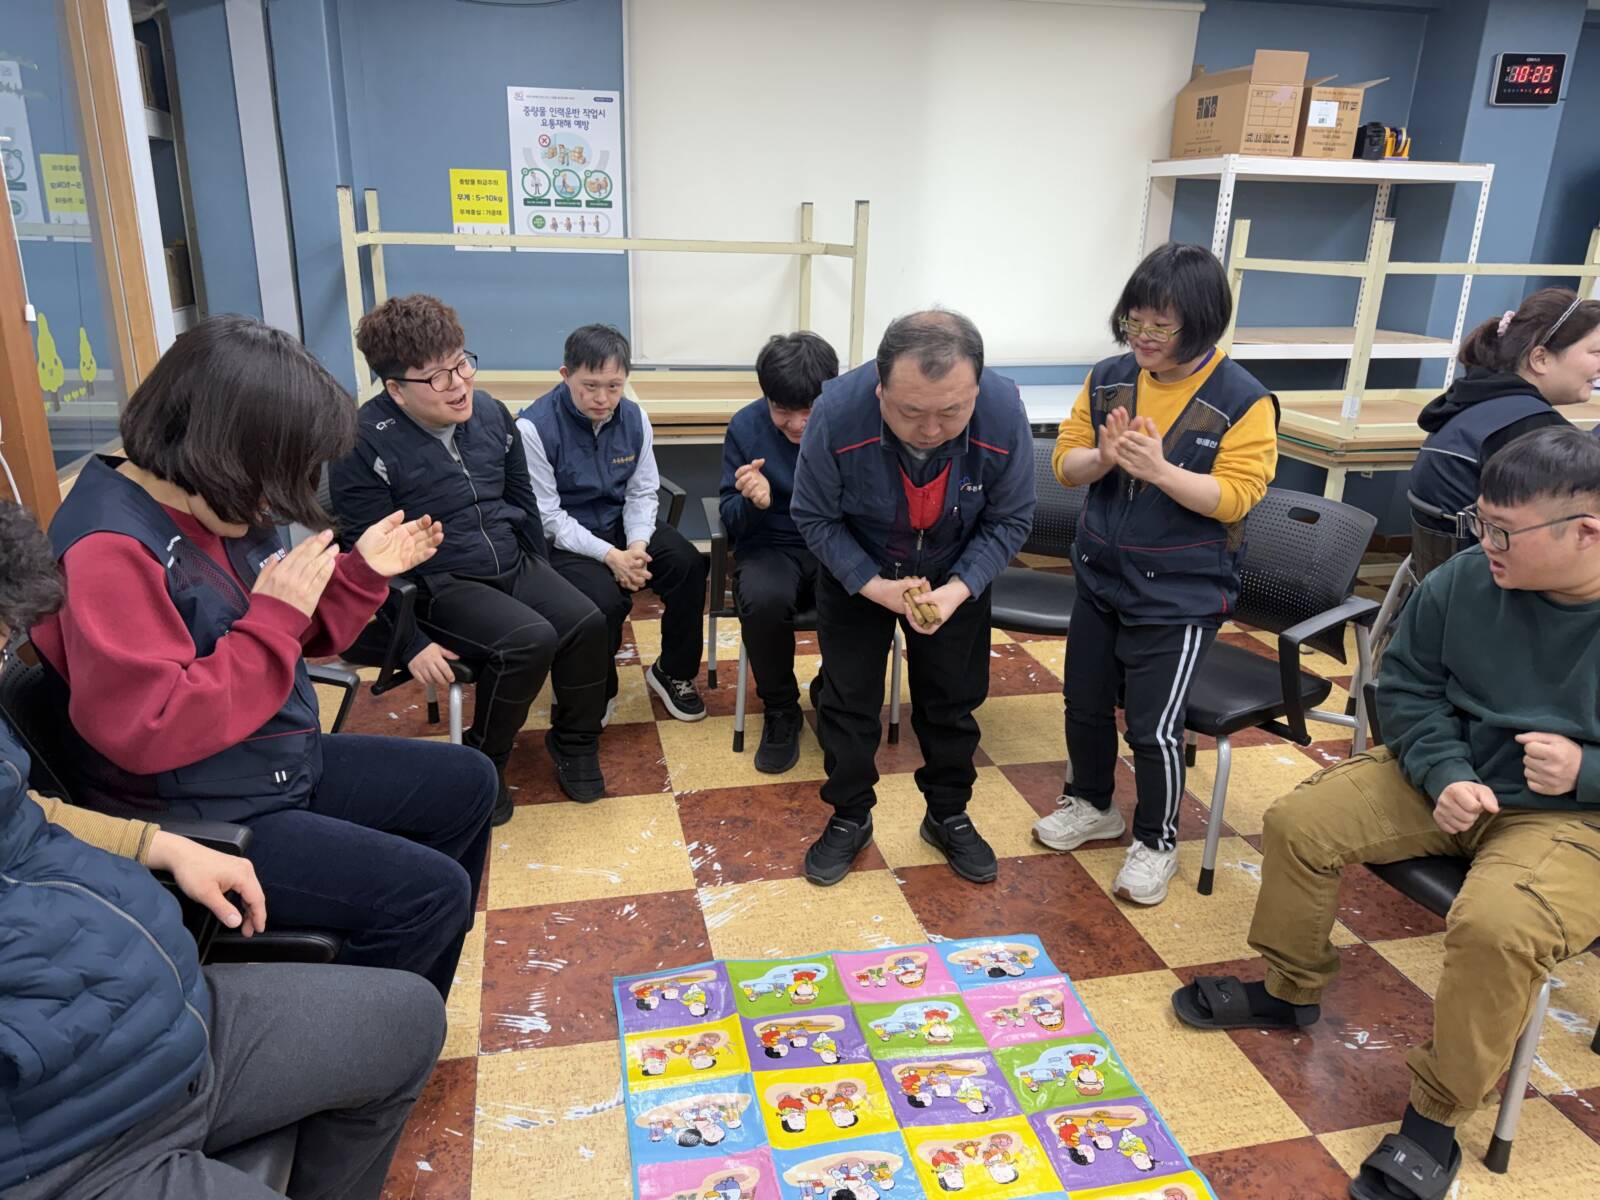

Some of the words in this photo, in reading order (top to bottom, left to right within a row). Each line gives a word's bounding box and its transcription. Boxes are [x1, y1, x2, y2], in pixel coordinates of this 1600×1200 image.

[1512, 65, 1554, 83] 10:23
[523, 106, 547, 117] 중량물
[549, 107, 580, 118] 인력운반
[583, 108, 606, 119] 작업시
[540, 119, 571, 129] 요통재해
[574, 119, 590, 131] 예방
[457, 193, 471, 201] 무게
